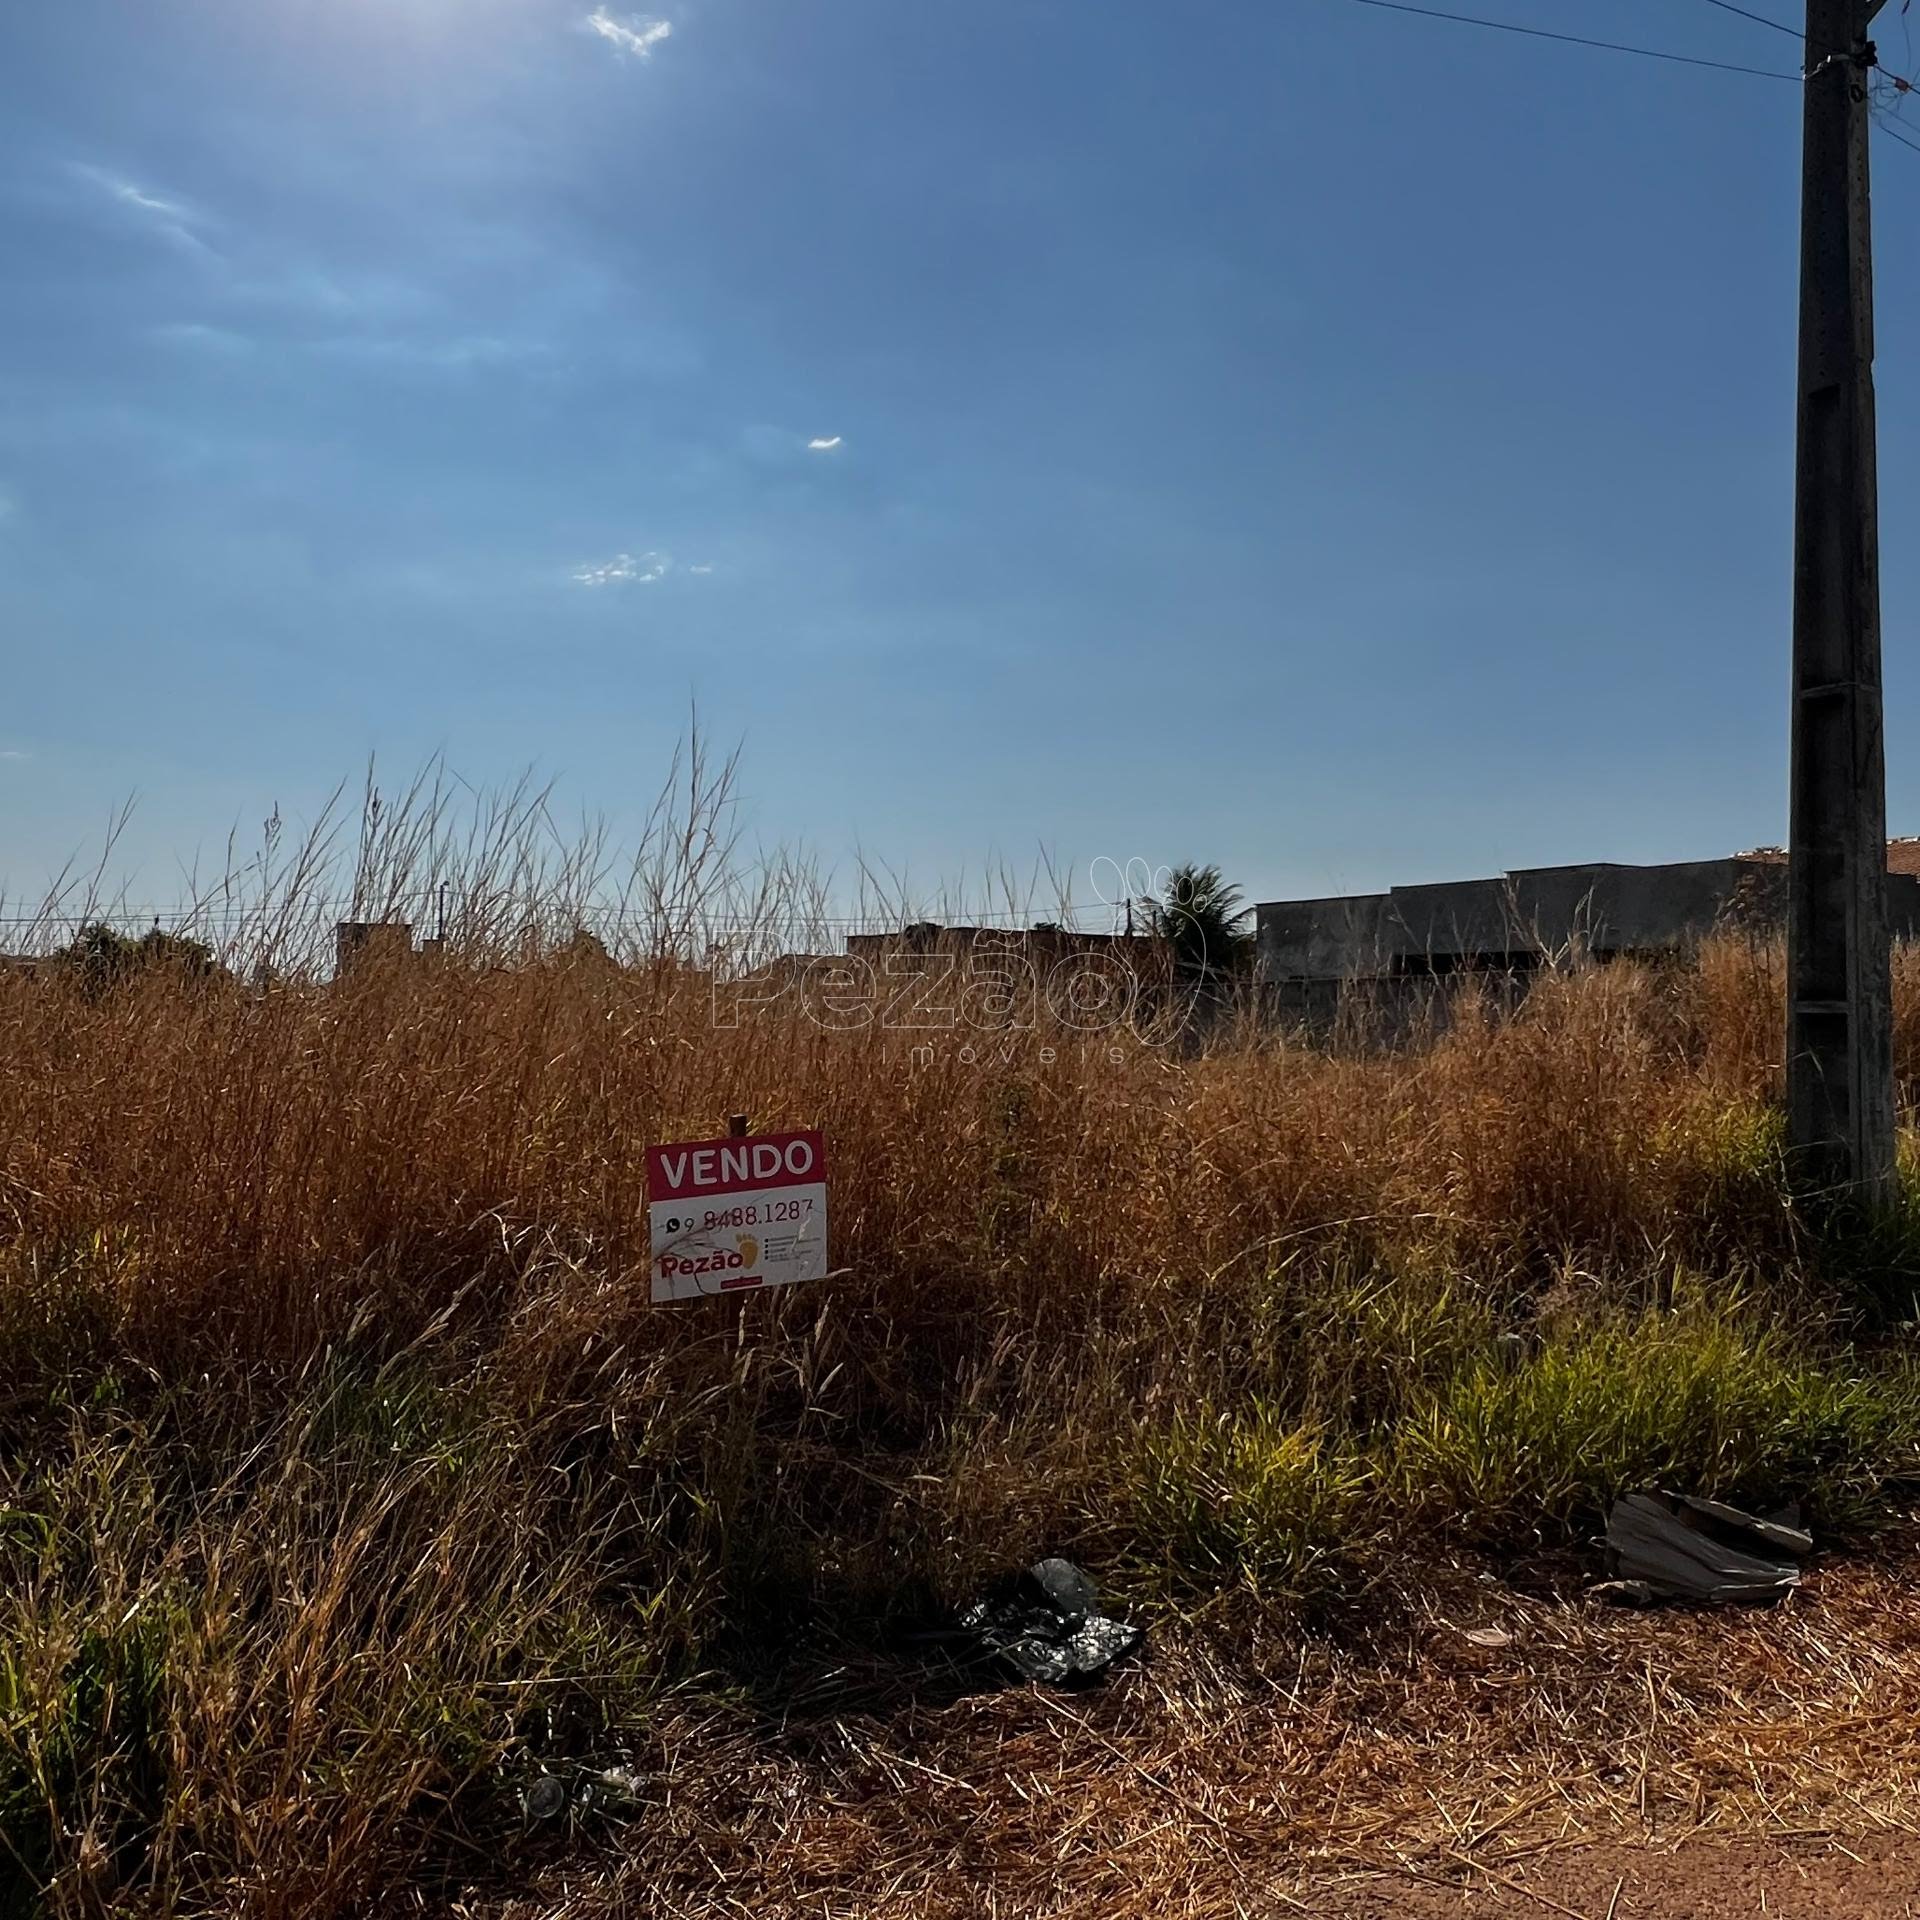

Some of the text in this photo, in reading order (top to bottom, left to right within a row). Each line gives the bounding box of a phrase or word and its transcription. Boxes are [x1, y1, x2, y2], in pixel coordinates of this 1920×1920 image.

[660, 1139, 814, 1189] VENDO
[683, 1198, 814, 1233] 9 8488.1287
[660, 1250, 744, 1279] Pezão
